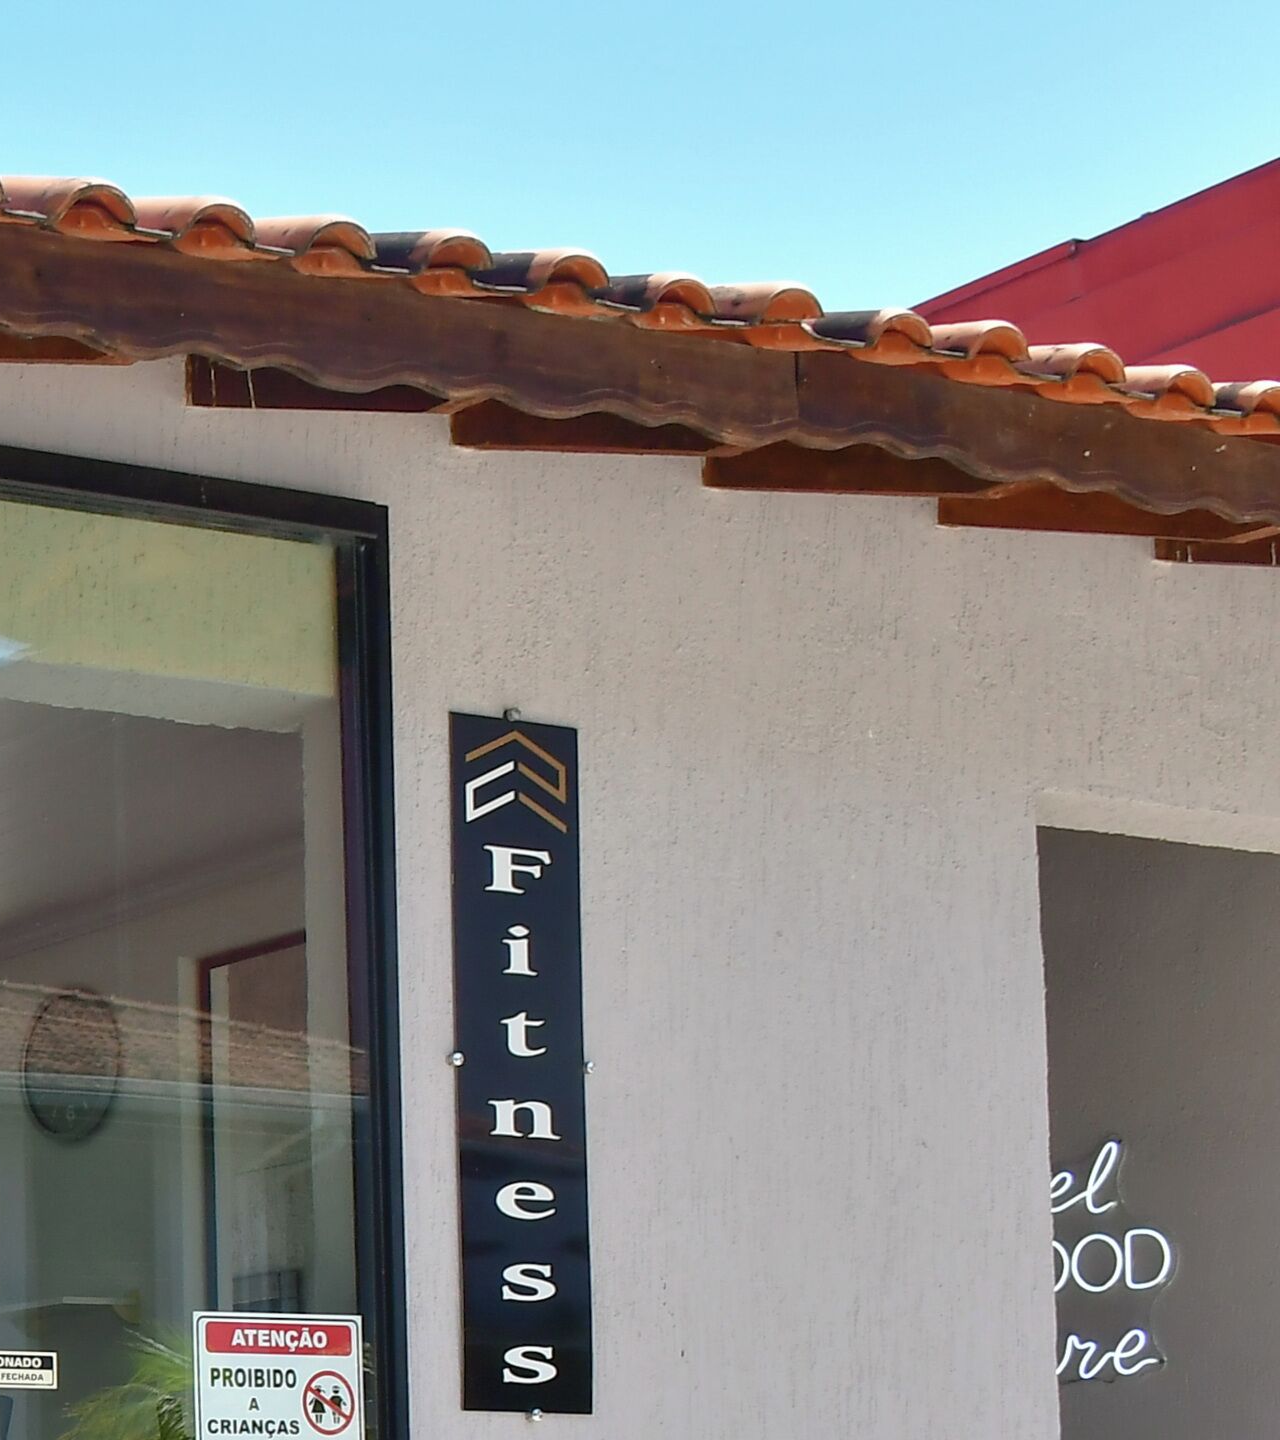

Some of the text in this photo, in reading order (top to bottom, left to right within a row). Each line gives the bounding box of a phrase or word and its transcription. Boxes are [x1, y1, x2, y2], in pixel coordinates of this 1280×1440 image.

[483, 844, 563, 1388] Fitness
[230, 1326, 328, 1353] ATENÇÃO
[1, 1372, 44, 1381] FECHADA
[209, 1366, 298, 1389] PROIBIDO
[248, 1397, 260, 1411] A
[207, 1419, 301, 1440] CRIANÇAS
